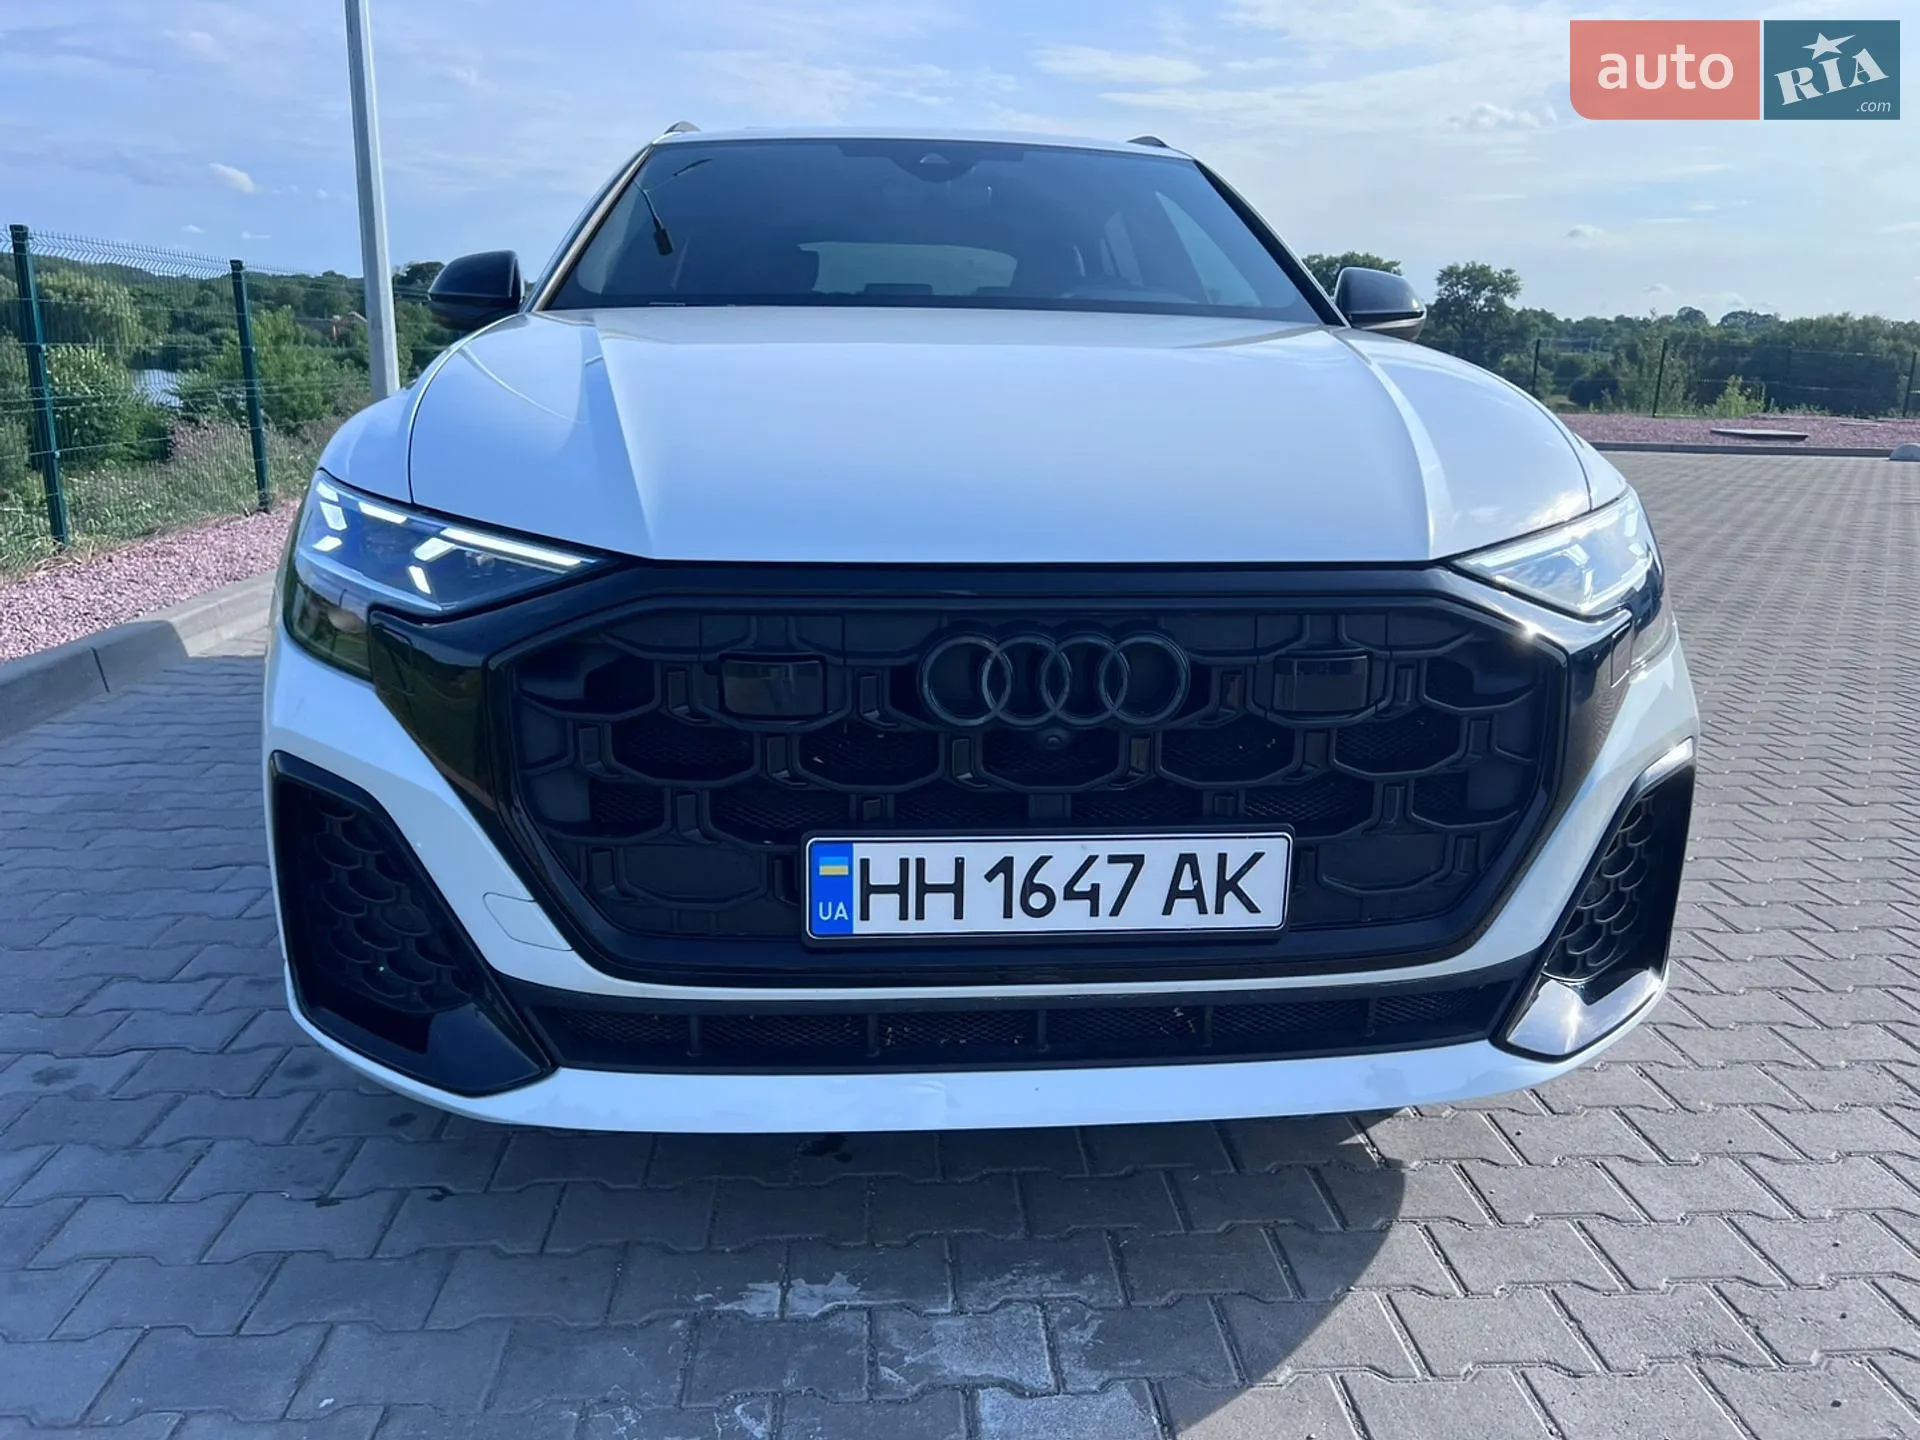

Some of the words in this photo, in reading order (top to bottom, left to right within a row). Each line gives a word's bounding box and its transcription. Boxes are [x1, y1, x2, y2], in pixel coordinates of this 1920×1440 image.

[859, 857, 965, 921] HH
[984, 854, 1145, 918] 1647
[1162, 851, 1265, 915] AK
[818, 902, 848, 921] UA
